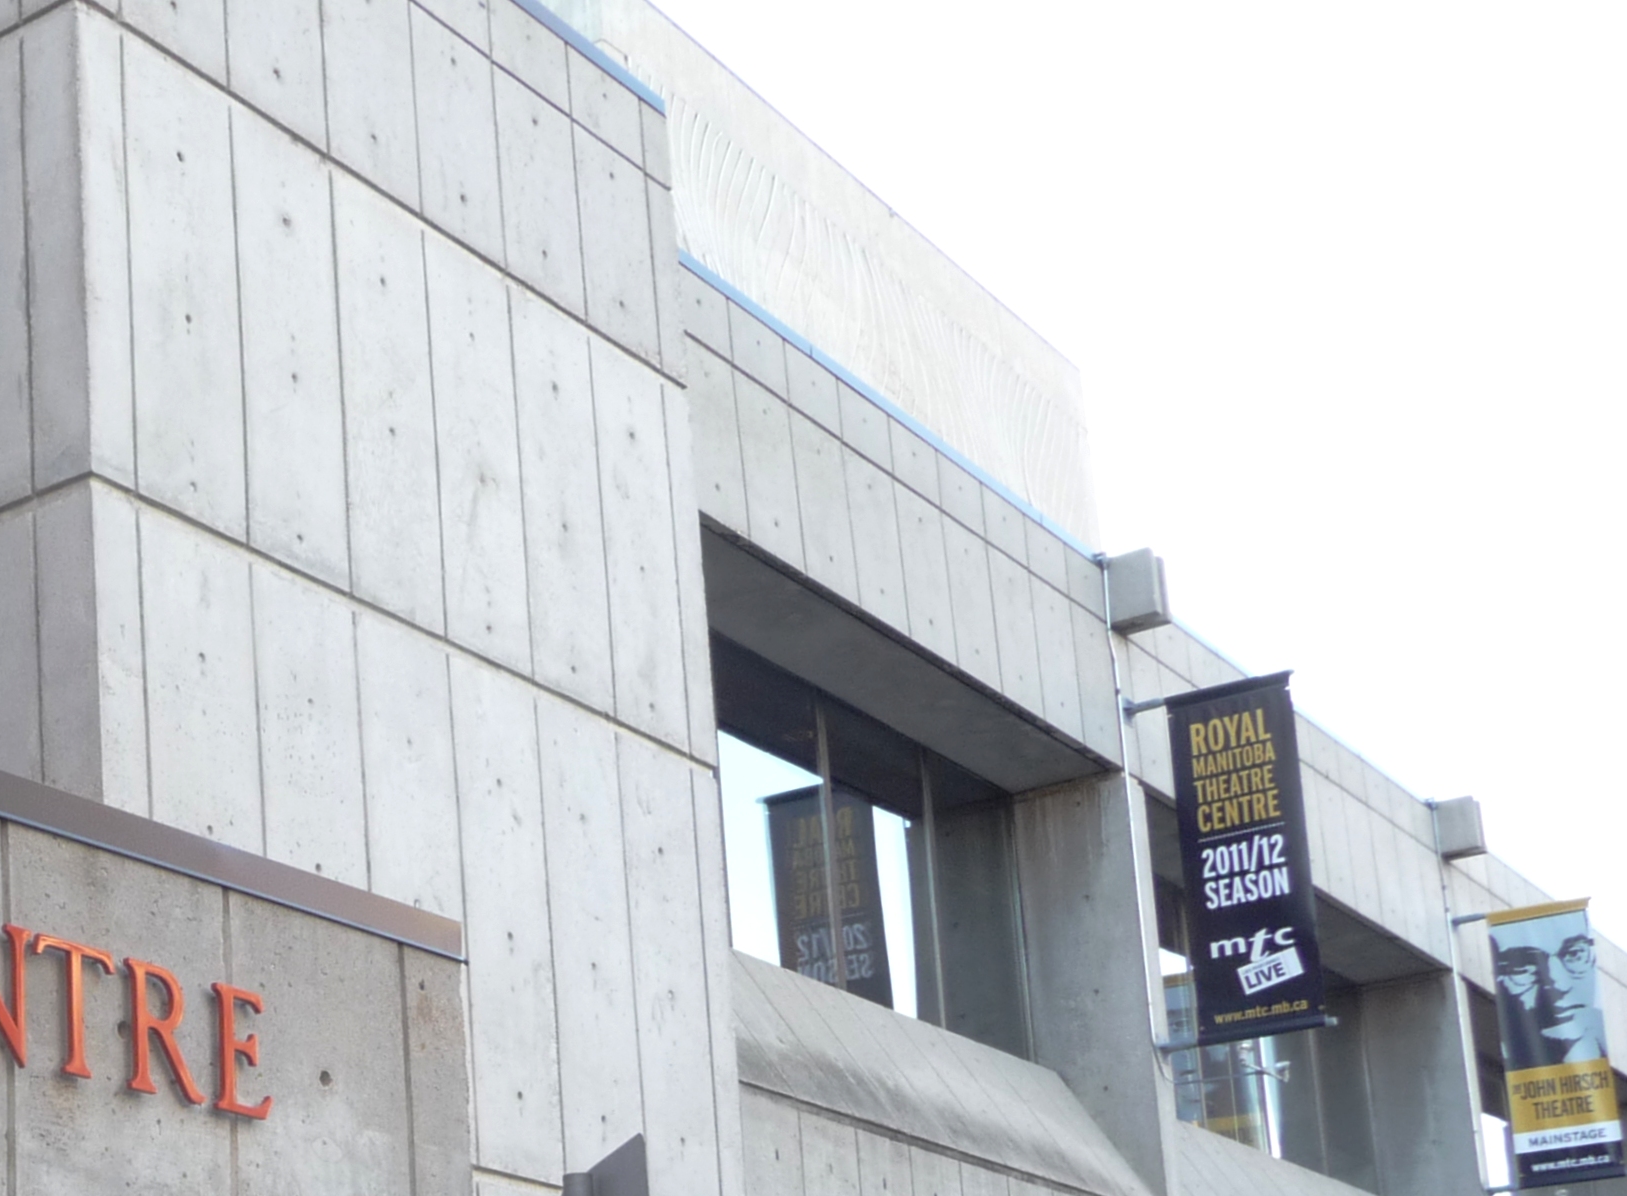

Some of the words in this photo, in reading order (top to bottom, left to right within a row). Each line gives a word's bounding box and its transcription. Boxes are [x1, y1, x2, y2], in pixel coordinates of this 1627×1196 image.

[1189, 708, 1271, 756] ROYAL
[1192, 741, 1276, 778] MANITOBA
[1193, 764, 1276, 804] THEATRE
[1197, 789, 1281, 833] CENTRE
[1201, 834, 1286, 879] 2011/12
[1204, 866, 1290, 909] SEASON
[1210, 927, 1295, 962] mtc
[1245, 962, 1286, 989] LIVE
[1214, 999, 1309, 1024] www.mtc.mb.ca
[1520, 1078, 1556, 1100] JOHN
[1559, 1070, 1611, 1094] HIRSCH
[1532, 1094, 1594, 1120] THEATRE
[1528, 1127, 1608, 1147] MAINSTAGE
